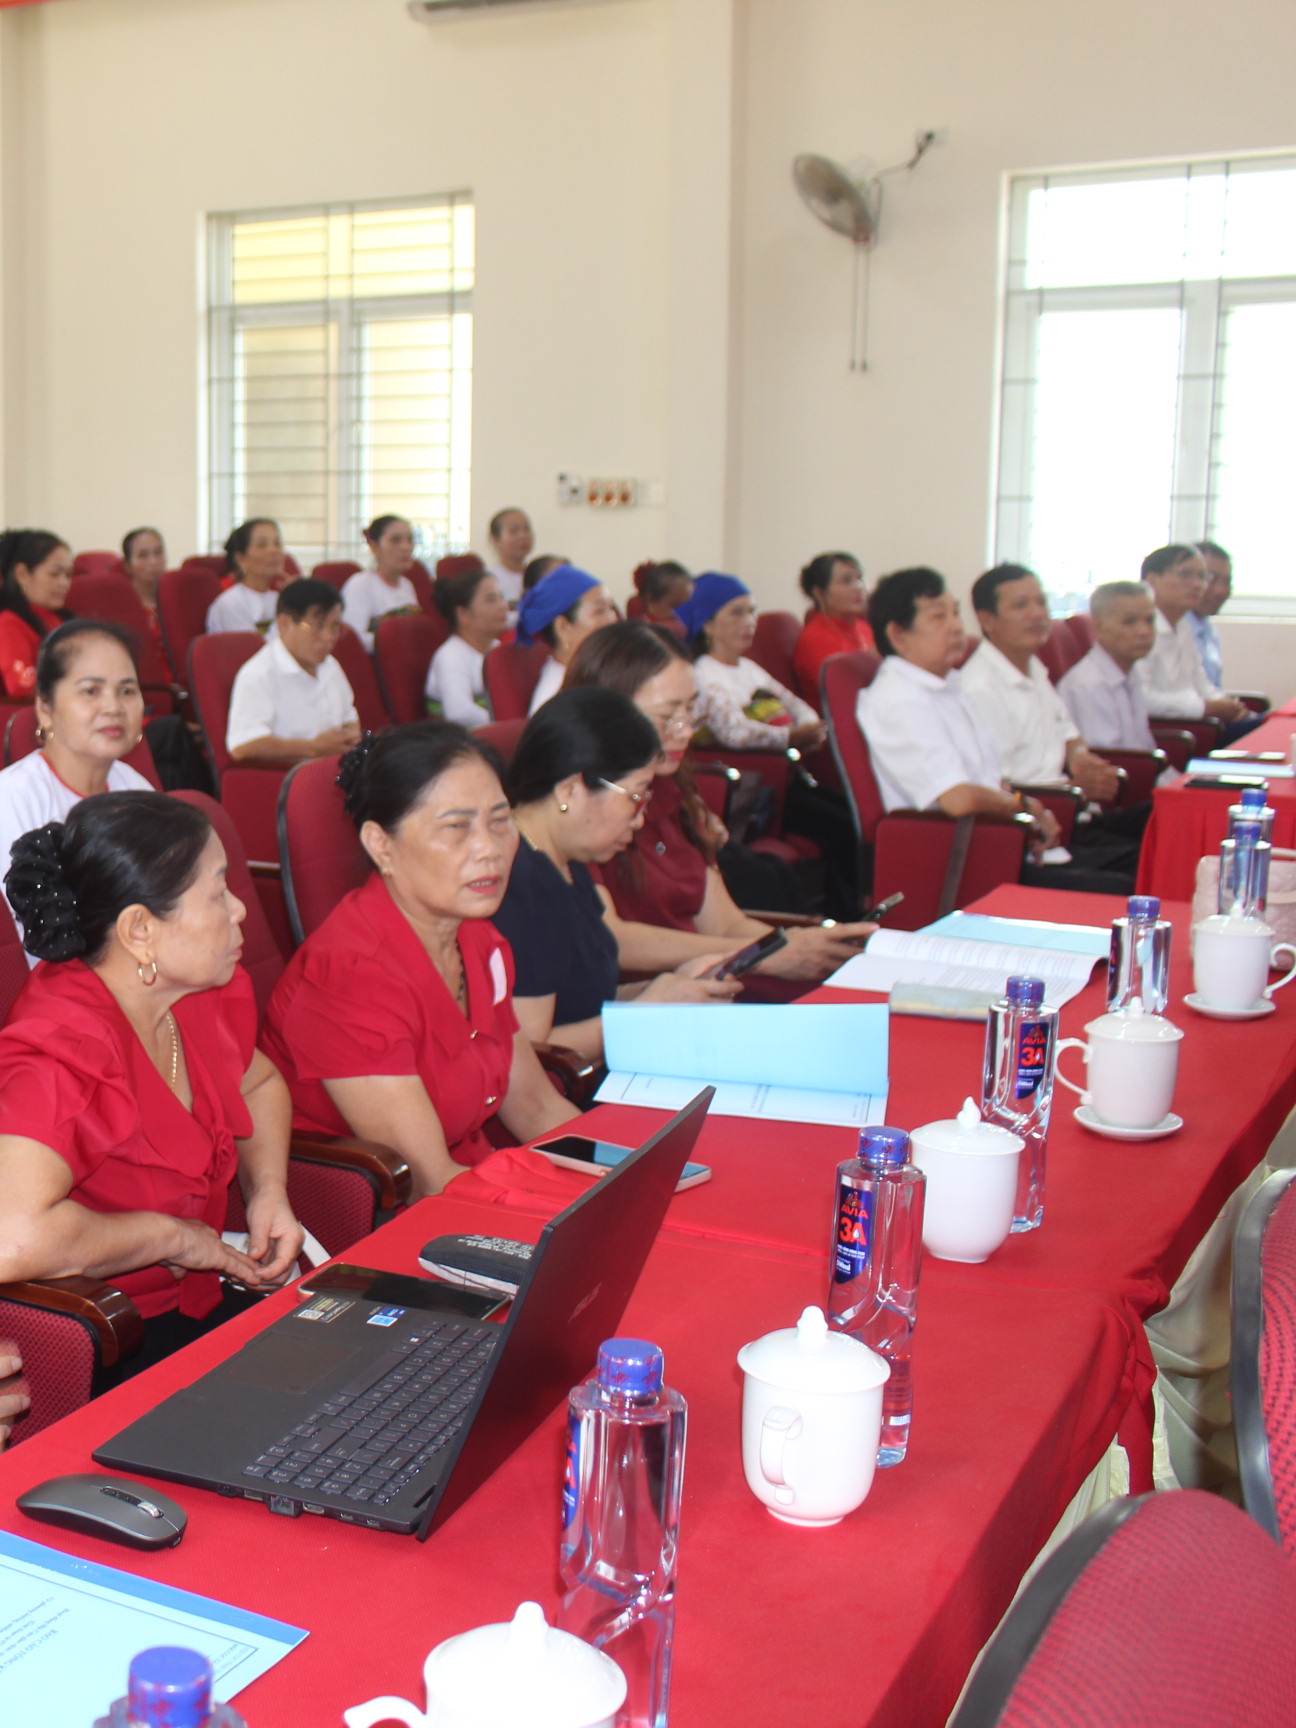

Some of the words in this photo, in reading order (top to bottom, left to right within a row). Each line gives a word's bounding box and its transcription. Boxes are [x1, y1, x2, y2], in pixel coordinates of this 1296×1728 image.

[1021, 1047, 1044, 1066] 3A
[841, 1203, 870, 1219] AVIA
[839, 1216, 868, 1247] 3A
